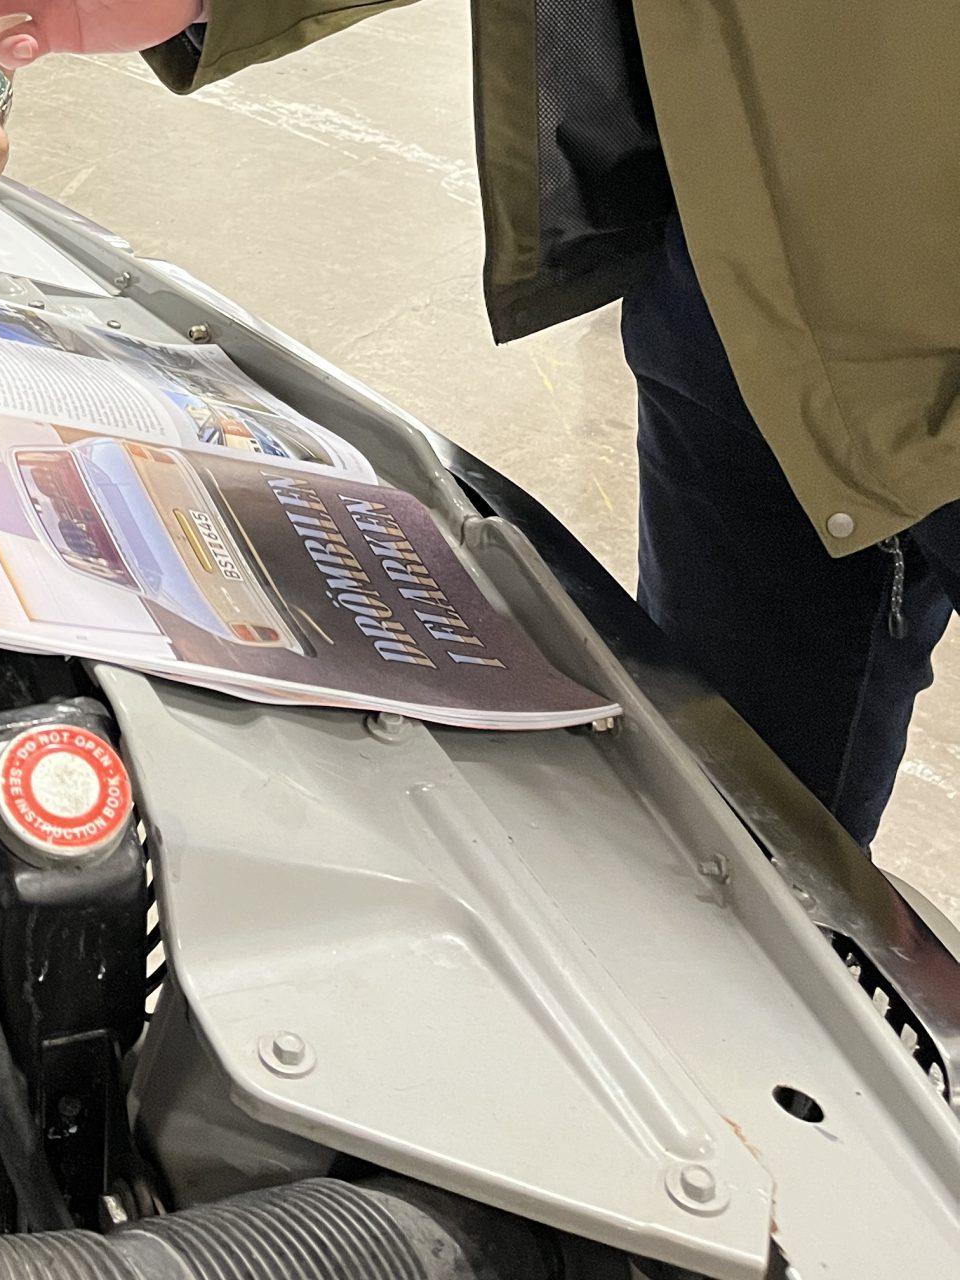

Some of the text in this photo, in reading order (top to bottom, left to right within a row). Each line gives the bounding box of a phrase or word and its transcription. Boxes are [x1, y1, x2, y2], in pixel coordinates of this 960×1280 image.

[262, 471, 437, 670] DRÖMBILEN
[337, 493, 507, 669] I FLARKEN
[9, 768, 121, 839] SEE INSTRUCTION BOOK
[16, 731, 111, 766] DO NOT OPEN
